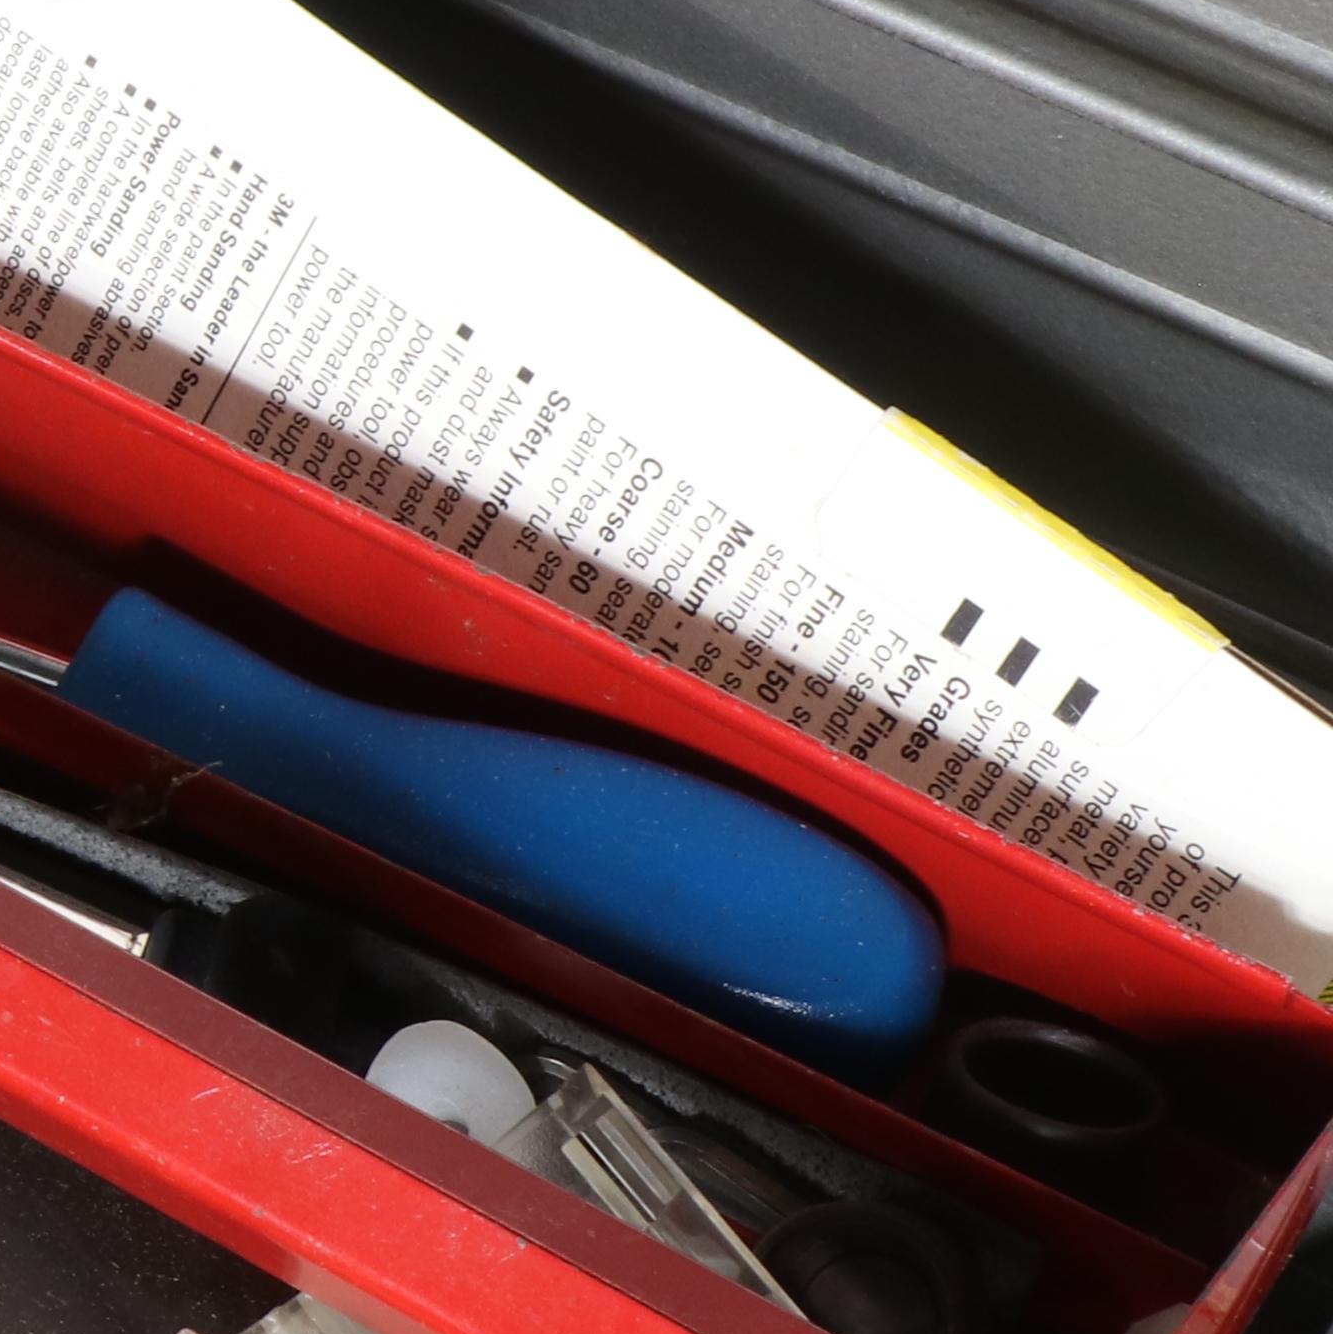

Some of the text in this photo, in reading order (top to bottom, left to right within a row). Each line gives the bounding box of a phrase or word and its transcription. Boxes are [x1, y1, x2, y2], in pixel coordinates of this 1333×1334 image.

[18, 58, 71, 144] adhesive
[20, 44, 53, 90] lasts
[60, 71, 92, 117] Also
[64, 85, 110, 152] sheets,
[112, 100, 131, 119] A
[15, 117, 67, 202] available
[41, 156, 75, 204] belts
[65, 118, 120, 207] complete
[89, 110, 181, 259] Power Sanding
[198, 162, 216, 180] A
[19, 205, 48, 246] and
[26, 114, 151, 322] In the hardware/power
[47, 208, 76, 245] line
[173, 181, 205, 228] wide
[267, 192, 294, 228] 3M
[35, 245, 54, 270] of
[70, 147, 197, 367] hand sanding abrasives
[125, 229, 179, 314] selection
[129, 177, 237, 355] In the paint section.
[179, 173, 268, 313] Hand Sanding
[241, 238, 268, 274] the
[3, 266, 43, 320] discs,
[203, 274, 249, 345] Leader
[252, 243, 330, 372] power tool.
[326, 266, 359, 306] the
[114, 314, 133, 339] of
[188, 345, 212, 368] in
[300, 285, 386, 412] information
[384, 319, 436, 396] power
[441, 342, 466, 365] If
[301, 300, 409, 482] procedures and
[351, 395, 396, 447] tool,
[415, 363, 452, 408] this
[458, 365, 495, 415] and
[358, 404, 423, 497] product
[426, 412, 467, 467] dust
[430, 383, 523, 527] Always wear
[507, 387, 571, 471] Safety
[599, 435, 639, 481] For
[511, 412, 607, 555] paint or rust.
[551, 478, 611, 552] heavy
[567, 456, 664, 595] Coarse 60
[622, 478, 696, 574] staining,
[688, 499, 727, 544] For
[678, 519, 755, 619] Medium
[709, 542, 785, 638] staining,
[734, 564, 817, 672] For finish
[755, 583, 846, 705] Fine 150
[799, 607, 877, 703] staining,
[867, 628, 909, 675] For
[848, 650, 938, 763] Very Fine
[899, 675, 972, 765] Grades
[986, 739, 1062, 834] aluminu
[1056, 779, 1119, 850] metal,
[1081, 801, 1150, 882] variety
[1178, 842, 1206, 871] of
[1189, 865, 1238, 915] This
